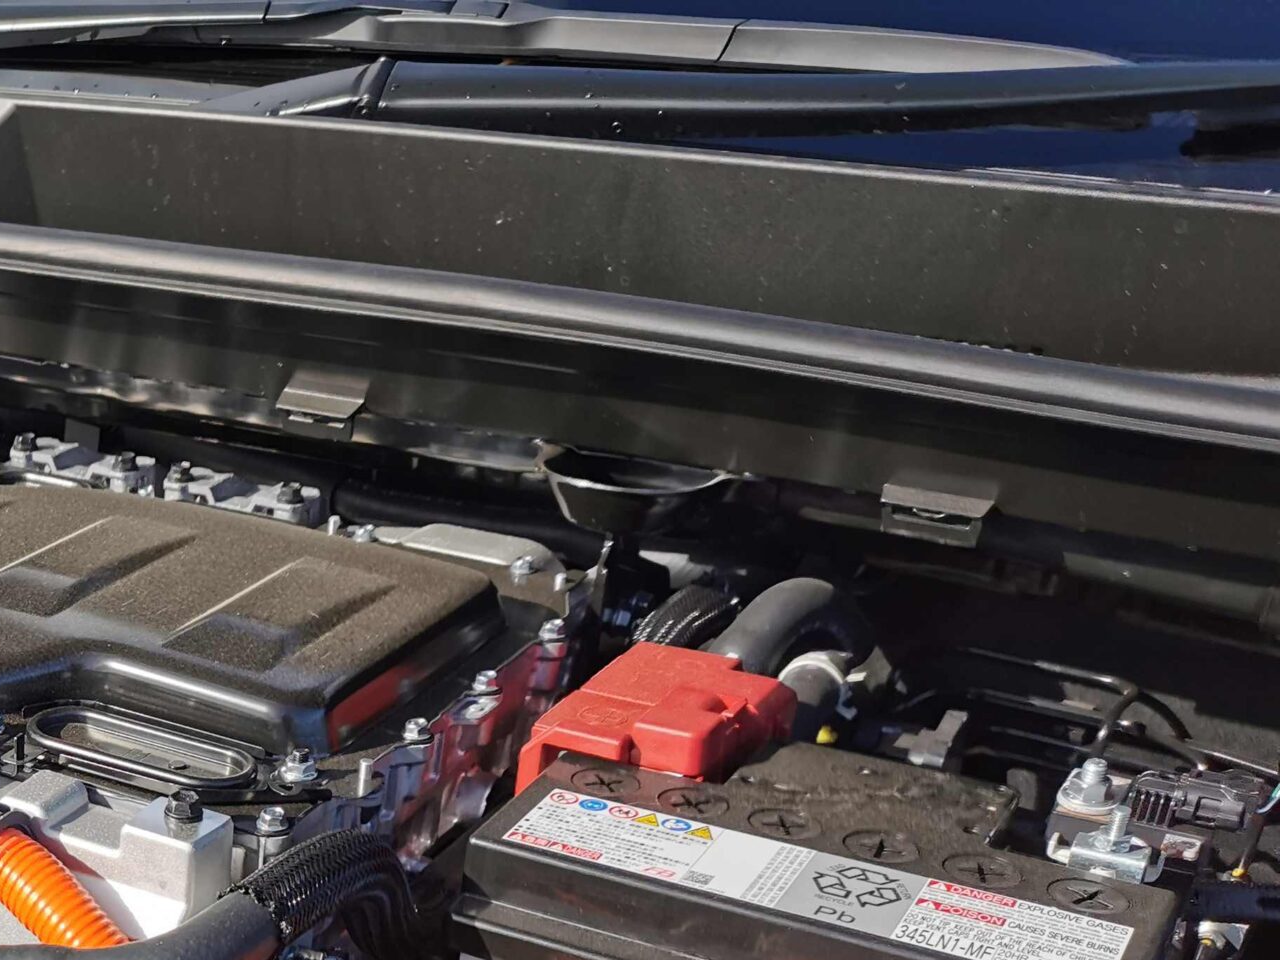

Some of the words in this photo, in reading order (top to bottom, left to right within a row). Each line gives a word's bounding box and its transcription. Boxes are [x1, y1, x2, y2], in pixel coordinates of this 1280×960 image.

[813, 905, 857, 924] Pb
[939, 904, 1005, 926] POISON
[1008, 921, 1046, 937] CAUSES
[1047, 930, 1085, 947] SEVERE
[1086, 940, 1121, 956] BURNS
[950, 883, 1016, 908] DANGER
[1017, 902, 1084, 925] EXPLOSIVE
[1086, 918, 1130, 937] GASES
[895, 924, 996, 960] 345LN1-MF
[904, 917, 924, 928] KEEP
[924, 923, 945, 934] VENT
[948, 928, 971, 940] CAPS
[972, 934, 996, 947] TIGHT
[996, 940, 1016, 951] AND
[907, 912, 919, 920] DO
[919, 914, 937, 924] NOT
[938, 919, 952, 929] TIP
[954, 923, 975, 934] KEEP
[976, 928, 992, 938] OUT
[993, 933, 1006, 941] OF
[1008, 936, 1024, 945] THE
[1025, 940, 1054, 953] REACH
[1055, 947, 1068, 956] OF
